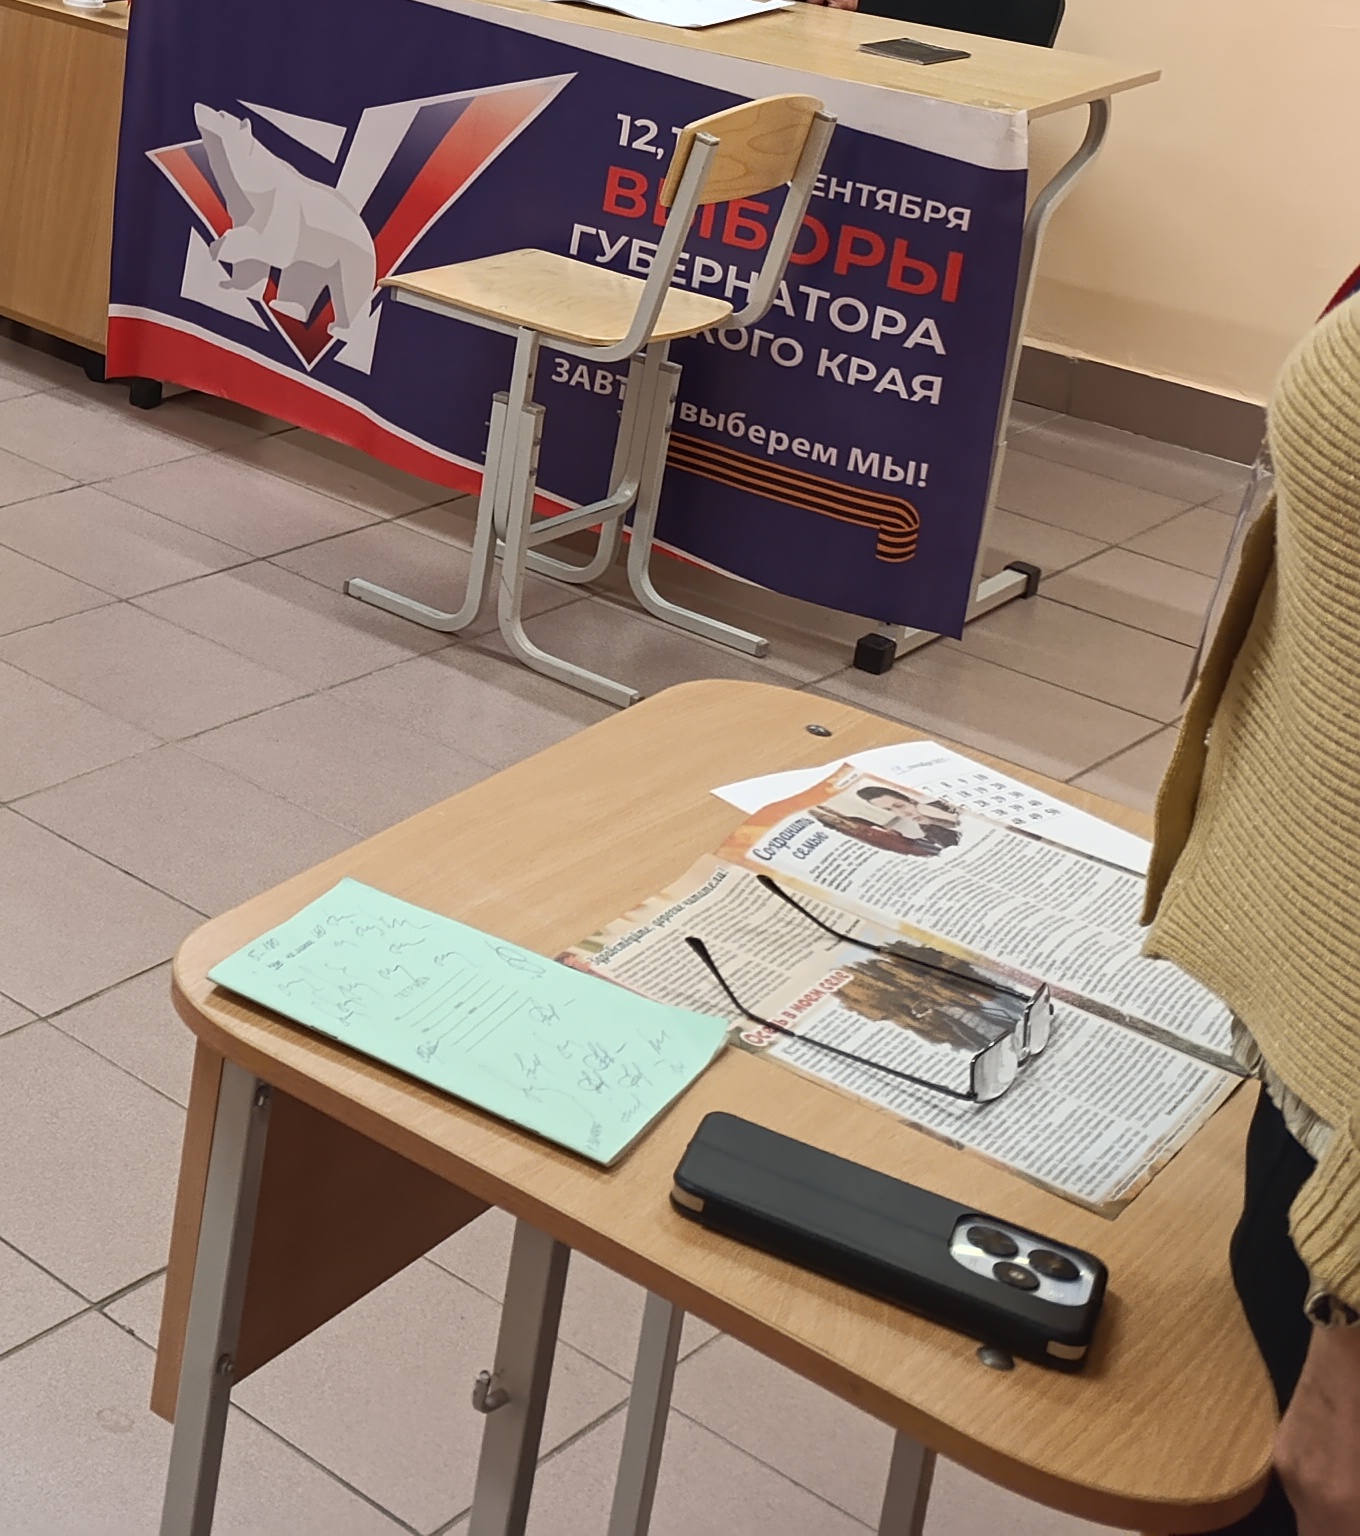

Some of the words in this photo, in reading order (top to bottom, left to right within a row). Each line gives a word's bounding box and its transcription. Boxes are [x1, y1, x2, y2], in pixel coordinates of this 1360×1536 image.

[787, 175, 972, 232] ЕНТЯБРЯ
[817, 347, 944, 406] КРАЯ
[680, 401, 838, 467] выберем
[846, 447, 929, 488] МЫ!
[752, 816, 816, 862] Сохранить
[792, 828, 829, 861] семью
[745, 1016, 789, 1046] Осеь
